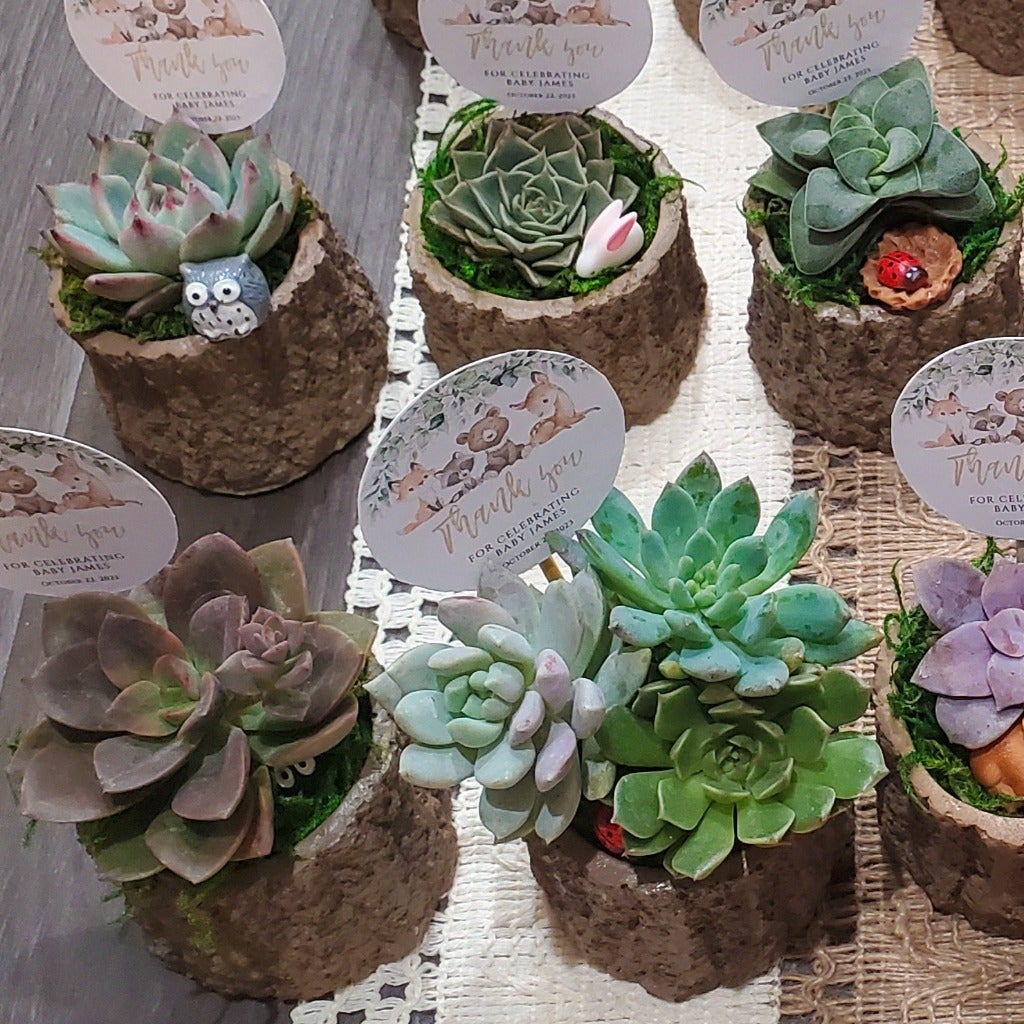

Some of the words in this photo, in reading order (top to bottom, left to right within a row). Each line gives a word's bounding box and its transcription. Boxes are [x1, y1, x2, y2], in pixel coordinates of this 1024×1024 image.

[466, 26, 553, 61] Thank
[563, 38, 604, 67] you
[756, 12, 840, 72] Thank
[848, 8, 886, 41] you
[125, 43, 206, 82] Thank
[212, 52, 250, 84] you
[483, 69, 507, 77] FOR
[511, 69, 591, 80] CELEBRATING
[782, 69, 804, 85] FOR
[806, 40, 881, 75] CELEBRATING
[803, 68, 831, 86] BABY
[834, 54, 868, 75] JAMES
[153, 92, 173, 101] FOR
[177, 90, 247, 99] CELEBRATING
[506, 78, 535, 87] BABY
[539, 79, 574, 88] JAMES
[203, 101, 236, 109] JAMES
[432, 470, 532, 554] Thank
[538, 449, 584, 493] you
[969, 495, 994, 505] FOR
[994, 504, 1024, 513] BABY
[76, 523, 126, 548] you
[468, 543, 494, 563] FOR
[496, 487, 582, 545] CELEBRATING
[495, 532, 527, 557] BABY
[530, 507, 568, 542] JAMES
[3, 561, 30, 570] FOR
[33, 552, 126, 567] CELEBRATING
[502, 540, 541, 569] OCTOBER
[32, 567, 65, 576] BABY
[71, 563, 112, 574] JAMES
[40, 579, 82, 587] OCTOBER
